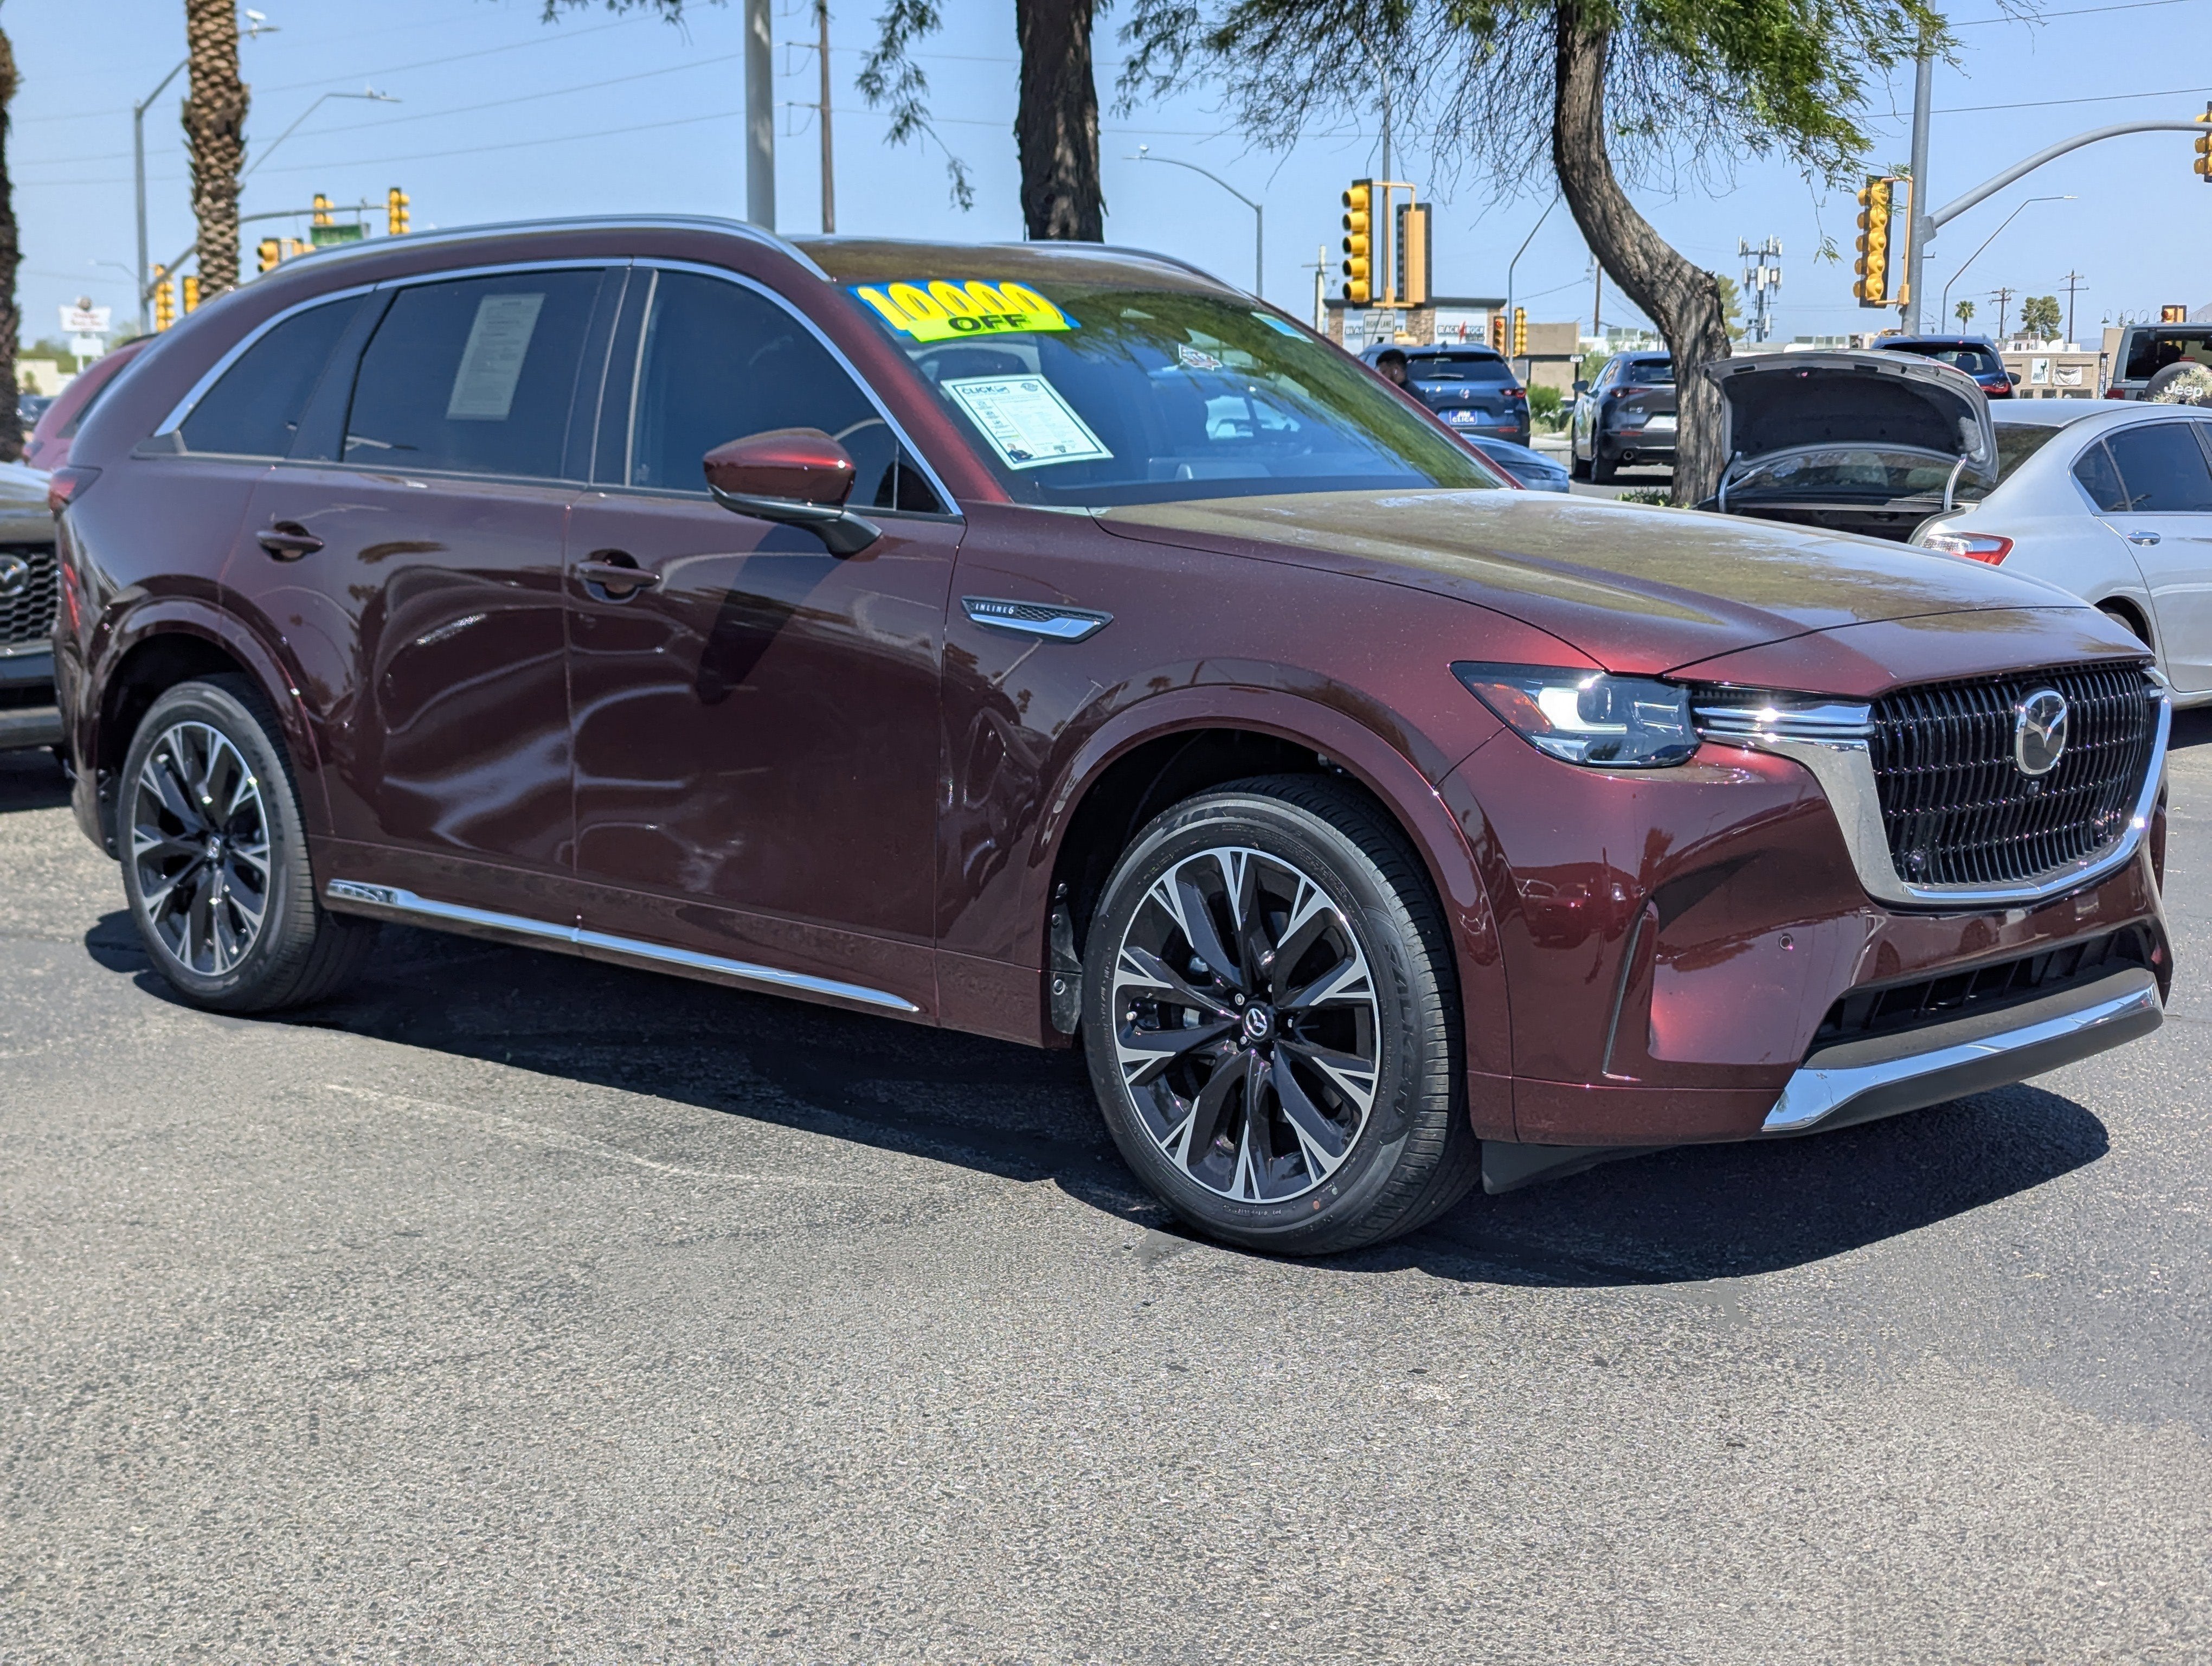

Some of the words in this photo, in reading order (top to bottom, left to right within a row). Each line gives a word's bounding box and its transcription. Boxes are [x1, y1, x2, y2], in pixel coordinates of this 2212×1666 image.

[857, 280, 1066, 330] 10000
[948, 313, 1029, 333] OFF
[1437, 325, 1459, 334] BLACK
[2164, 381, 2203, 399] Jeep
